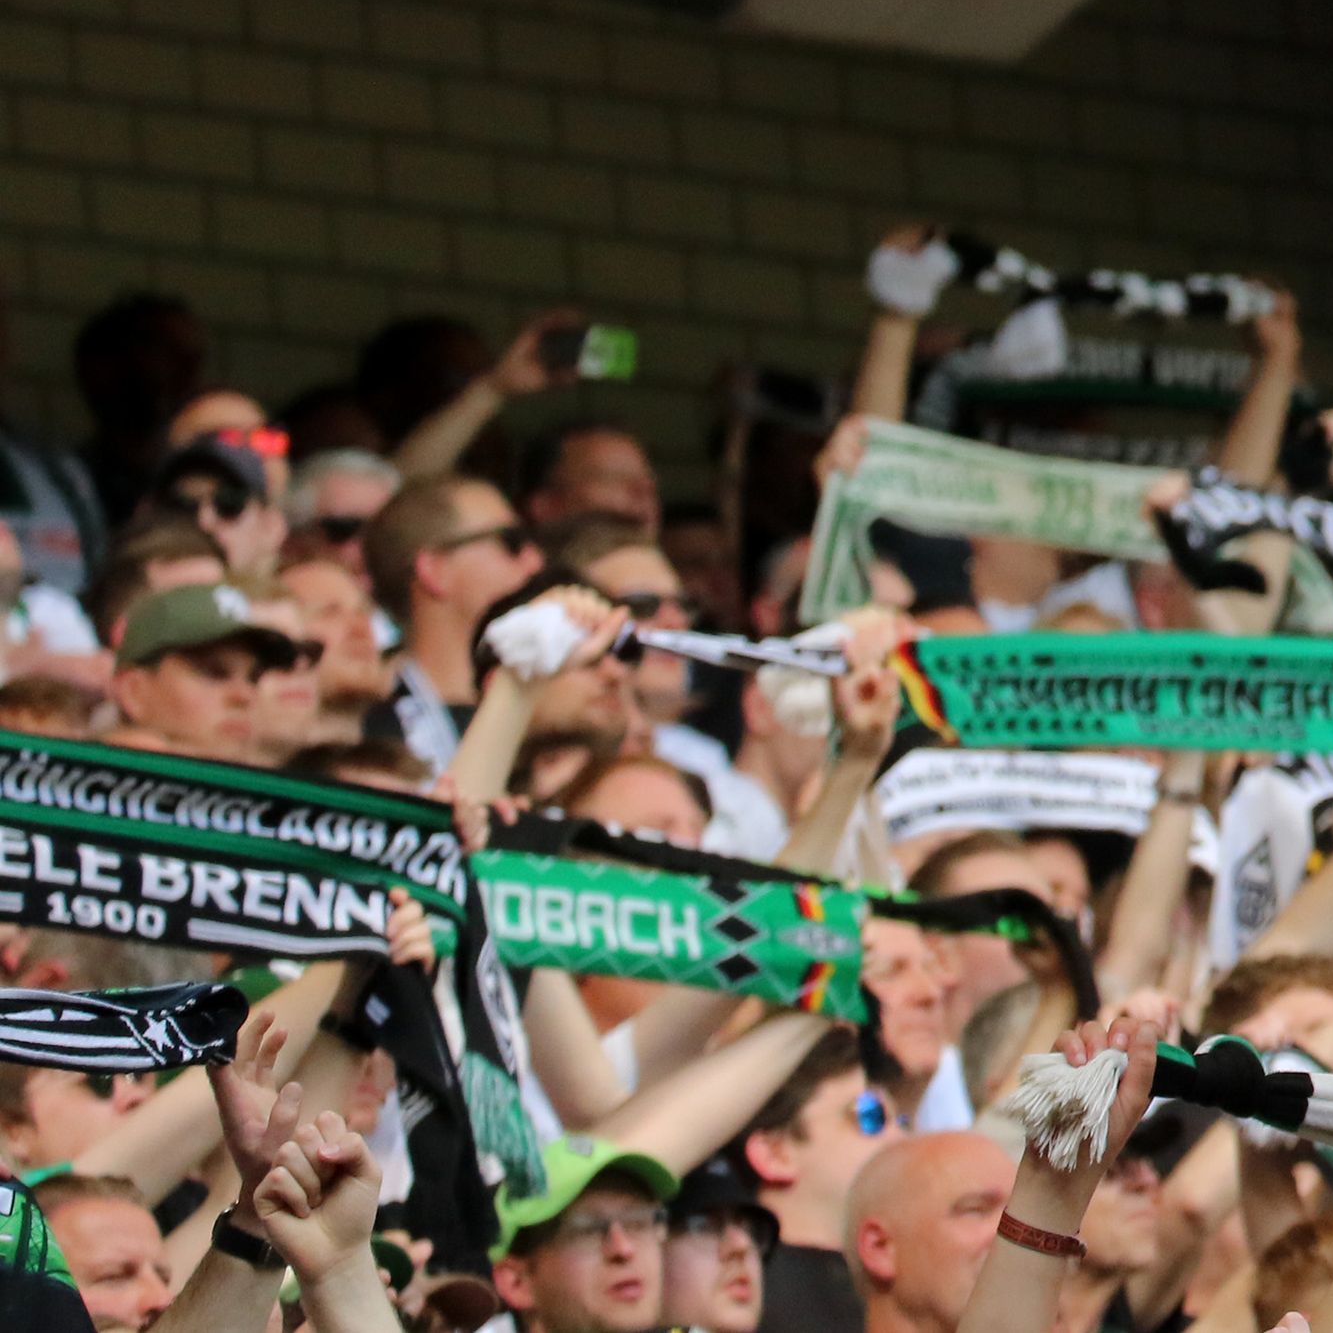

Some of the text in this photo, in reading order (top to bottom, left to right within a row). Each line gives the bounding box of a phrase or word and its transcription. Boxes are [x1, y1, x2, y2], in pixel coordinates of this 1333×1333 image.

[0, 749, 468, 909] ÖNCHENGLADBACH
[46, 892, 167, 940] 1900
[139, 853, 391, 935] BRENN
[477, 880, 703, 960] DBACH
